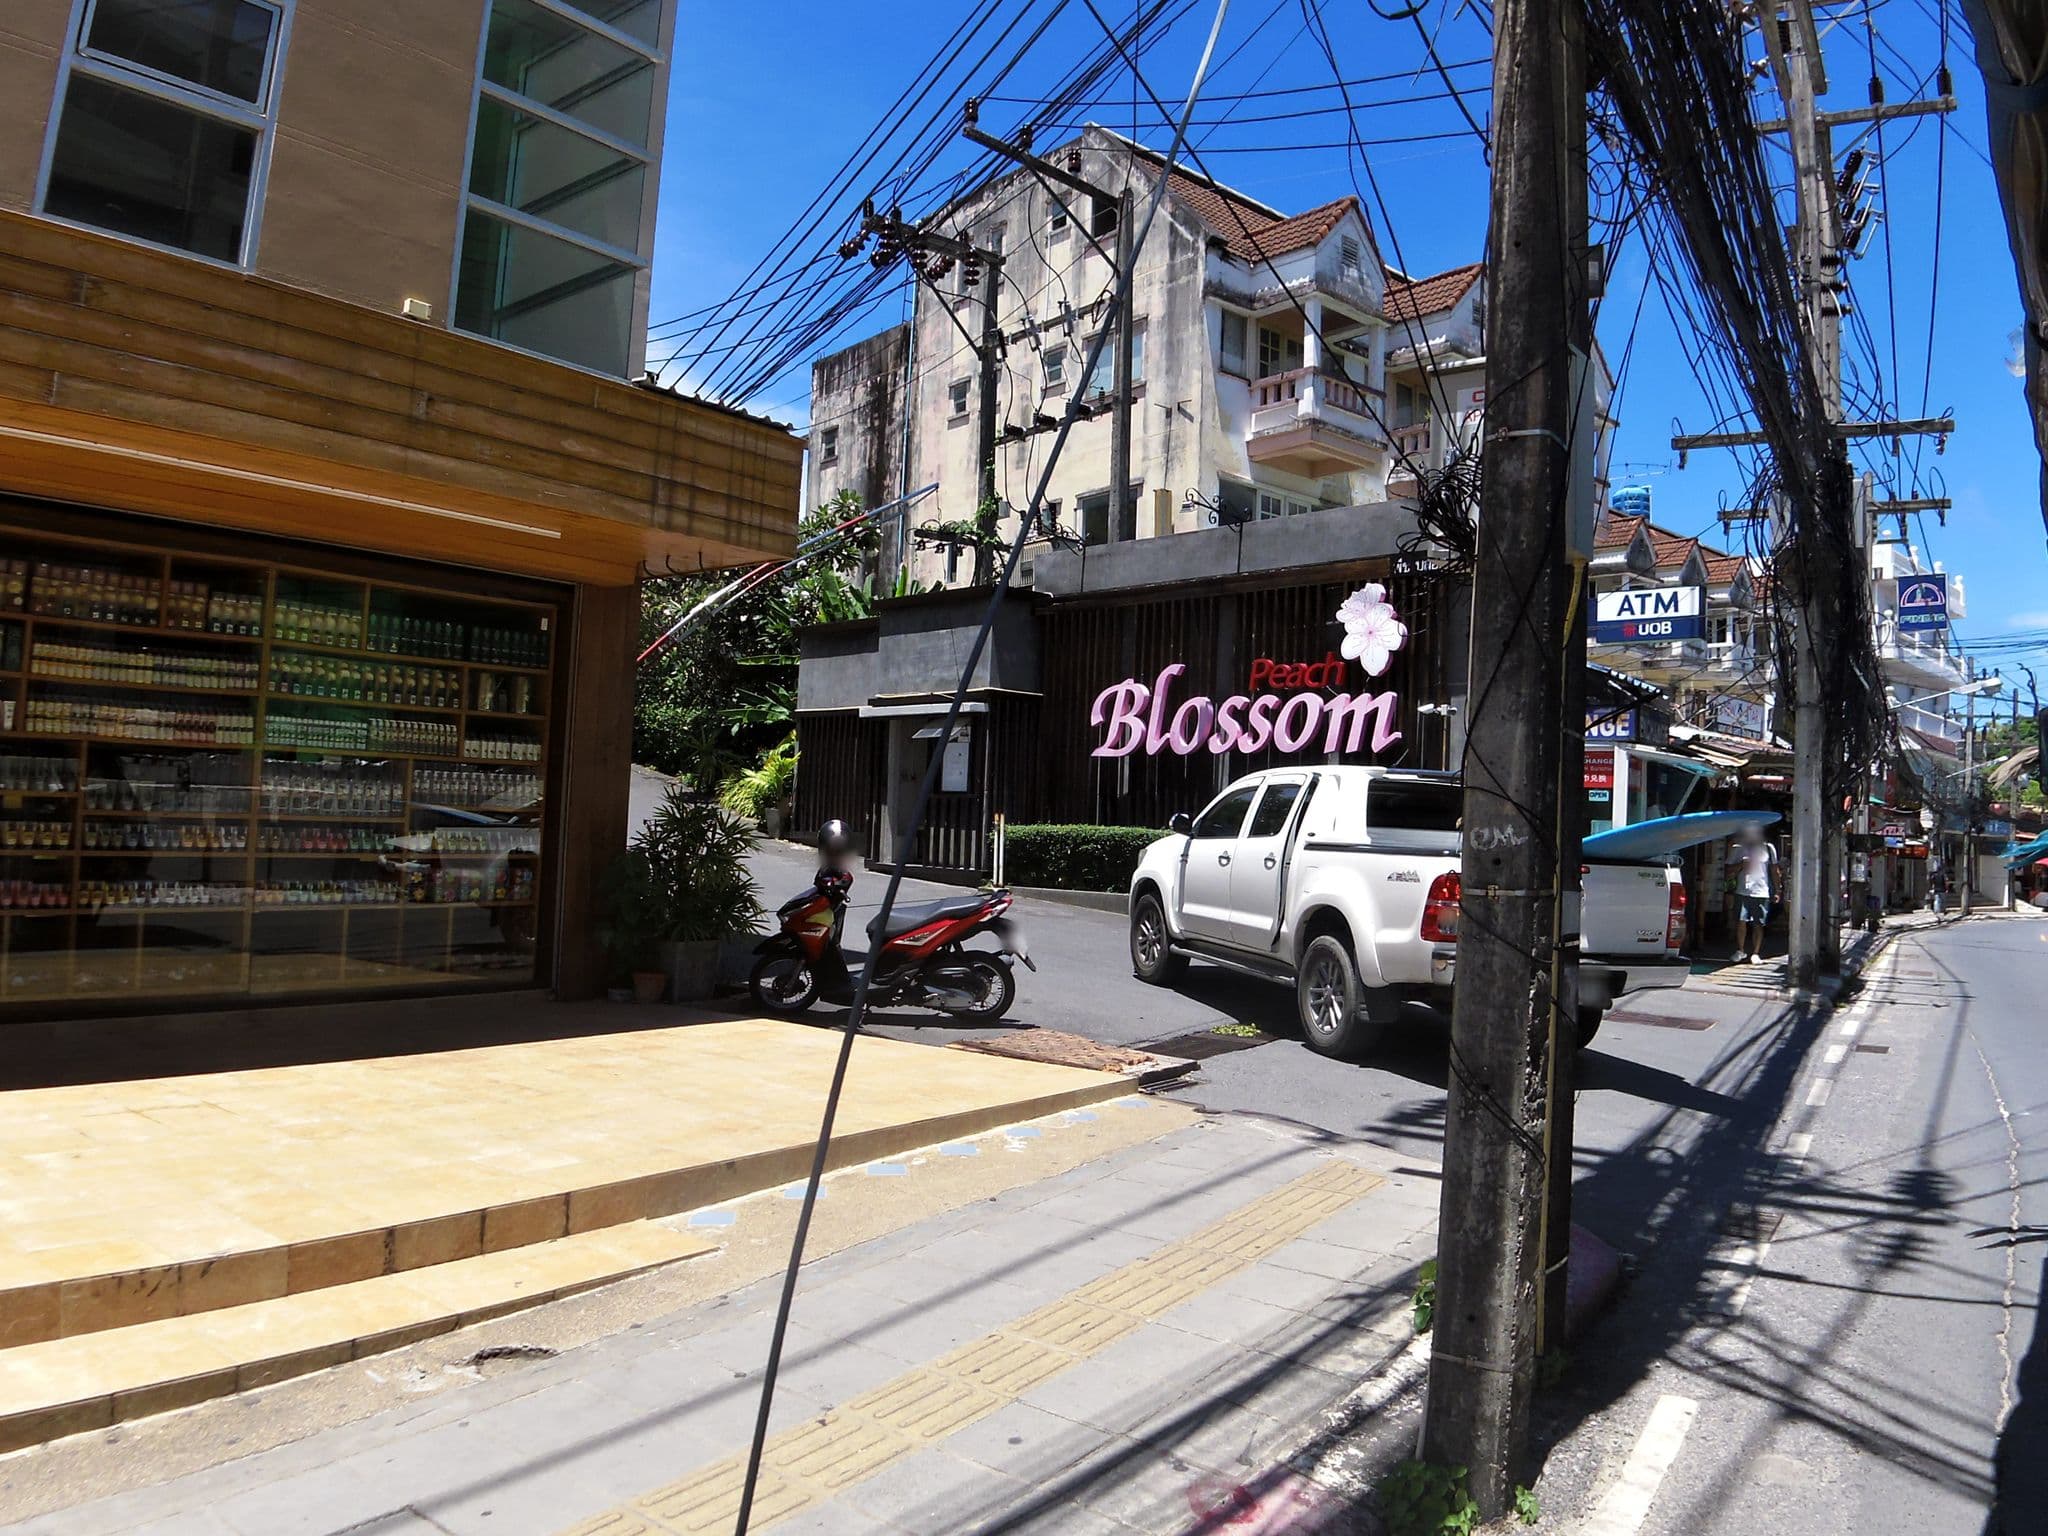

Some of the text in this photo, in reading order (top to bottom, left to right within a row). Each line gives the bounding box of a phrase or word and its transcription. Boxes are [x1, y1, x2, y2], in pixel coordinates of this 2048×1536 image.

[1617, 591, 1679, 616] ATM
[1638, 621, 1672, 635] UOB
[1249, 652, 1345, 691] Peach
[1091, 663, 1402, 757] Blossom
